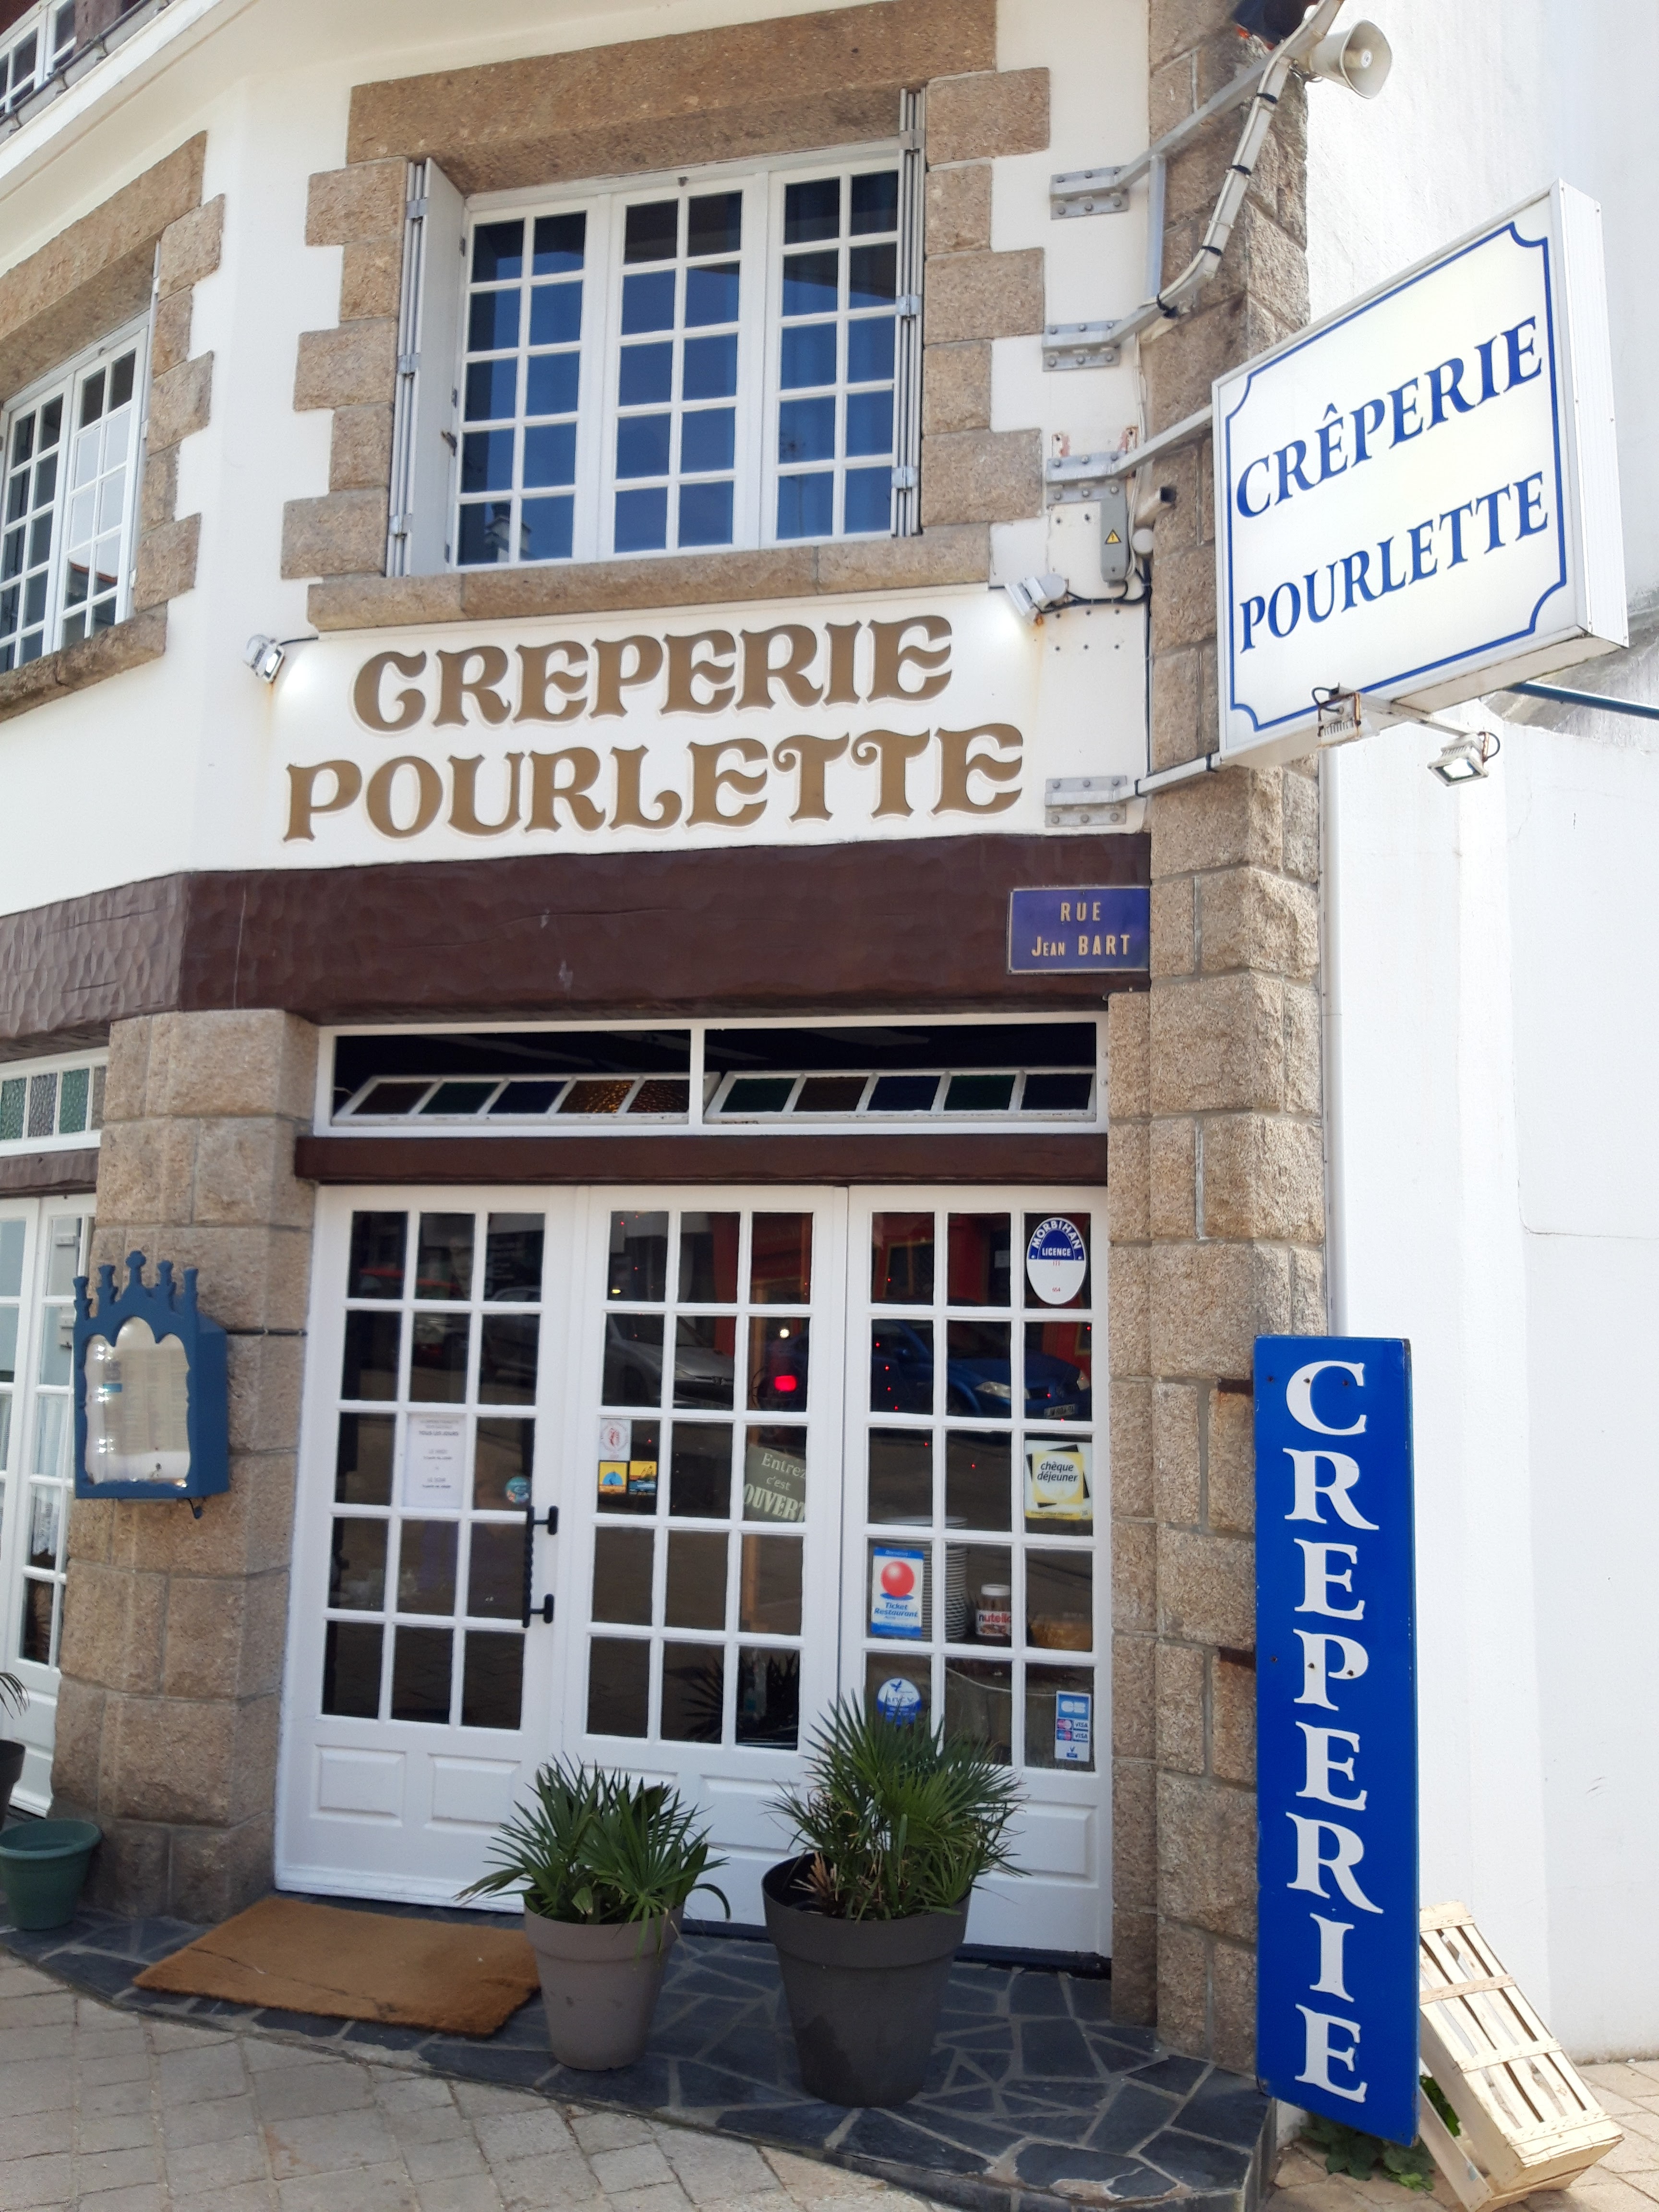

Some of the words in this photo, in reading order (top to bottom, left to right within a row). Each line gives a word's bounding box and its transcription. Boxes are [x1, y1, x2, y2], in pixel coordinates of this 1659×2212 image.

[1236, 316, 1542, 519] CRÊPERIE
[1239, 471, 1549, 654] POURLETTE
[353, 614, 953, 731] CREPERIE
[283, 722, 1023, 842] POURLETTE
[1060, 902, 1101, 922] RUE
[1078, 934, 1130, 956] BART
[1032, 1219, 1082, 1249] MORBIHAN
[1042, 1247, 1071, 1257] LICENCE
[1037, 1471, 1078, 1483] déjeuner
[1040, 1461, 1074, 1473] chèque
[766, 1476, 791, 1491] c'est
[874, 1607, 918, 1618] Restaurant
[885, 1602, 908, 1610] Ticket
[1282, 1359, 1384, 2104] CREPERIE
